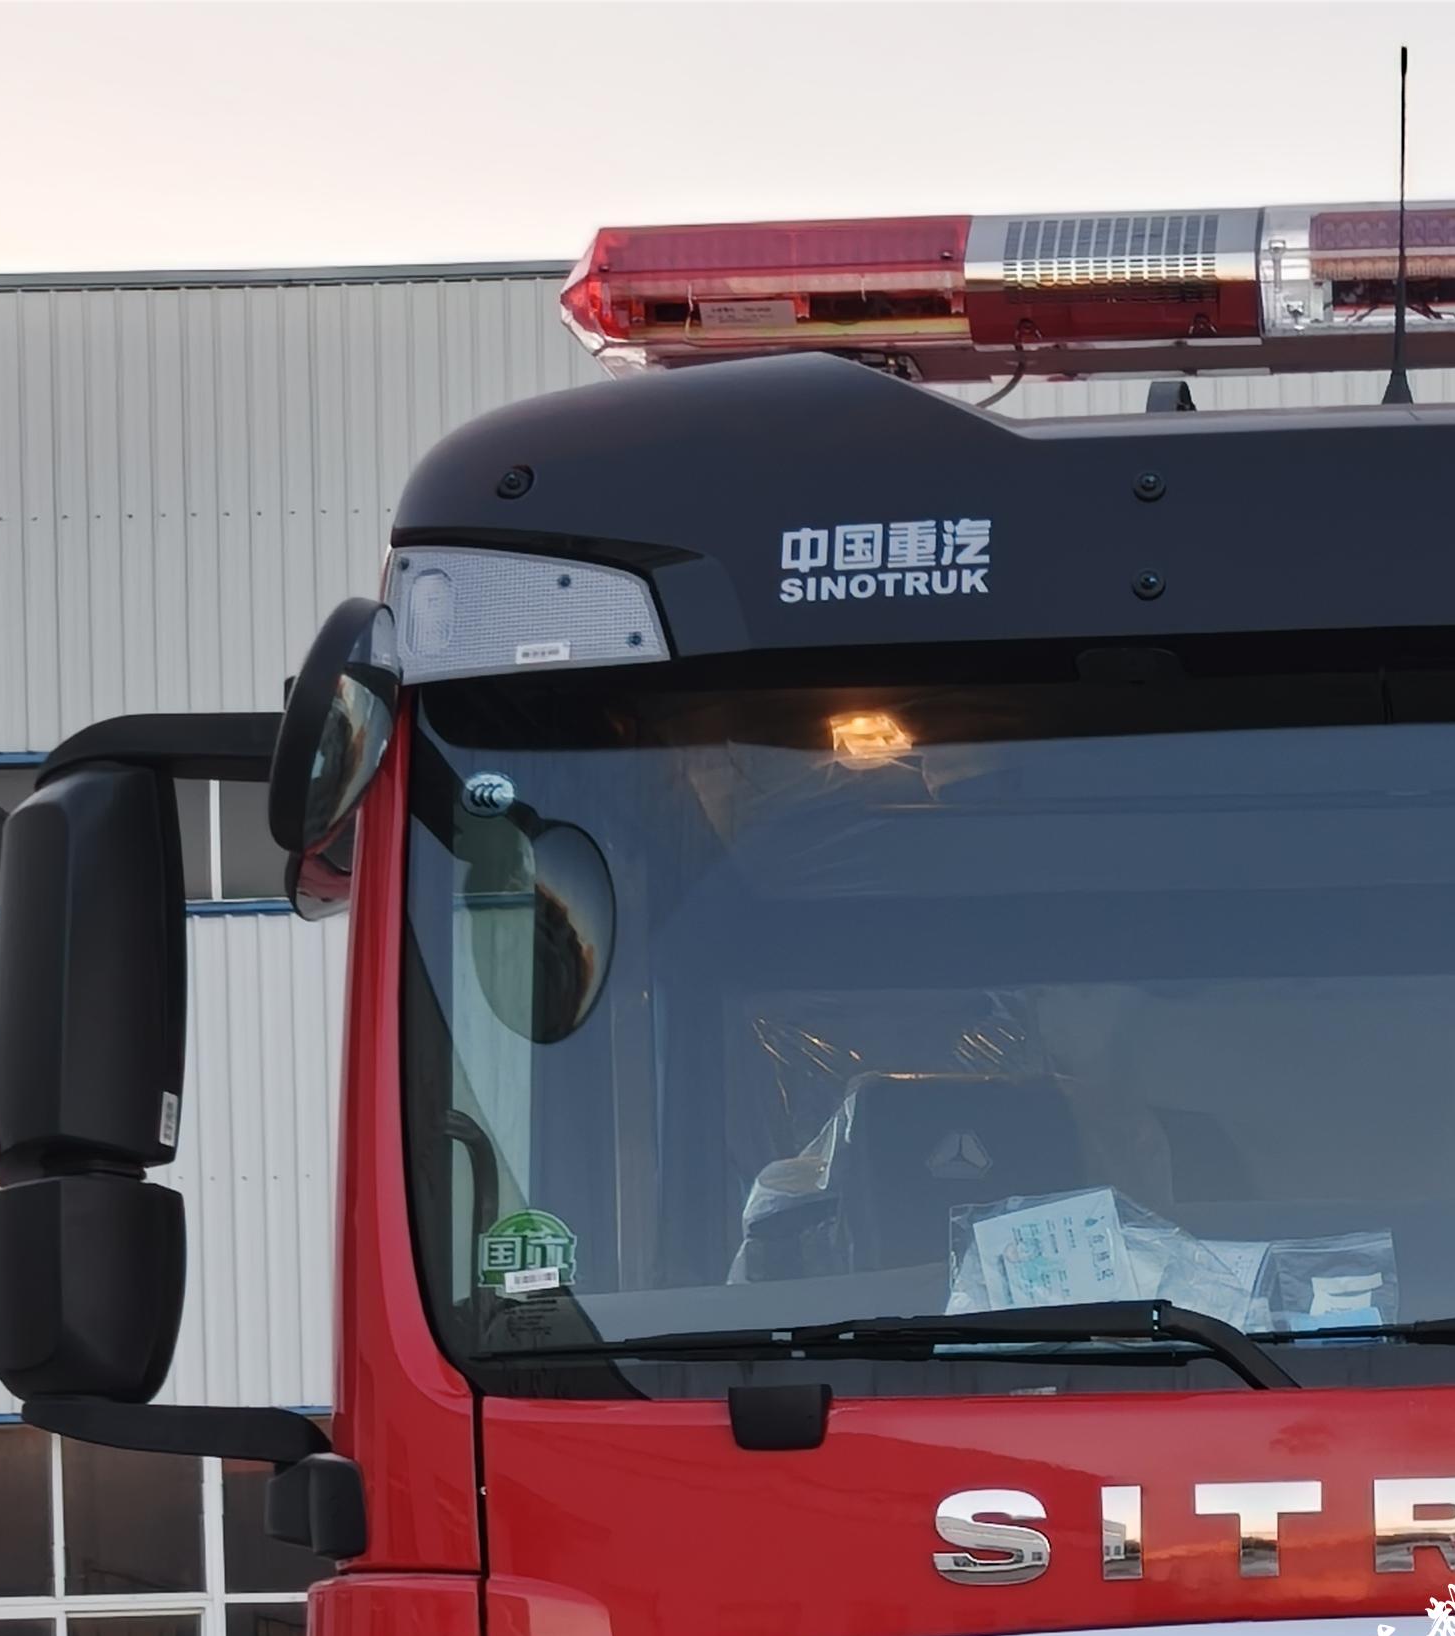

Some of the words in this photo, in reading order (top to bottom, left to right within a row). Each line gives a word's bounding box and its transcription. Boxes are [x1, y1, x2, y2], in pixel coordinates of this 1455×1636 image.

[780, 518, 992, 572] 中国重汽
[779, 567, 990, 604] SINOTRUK
